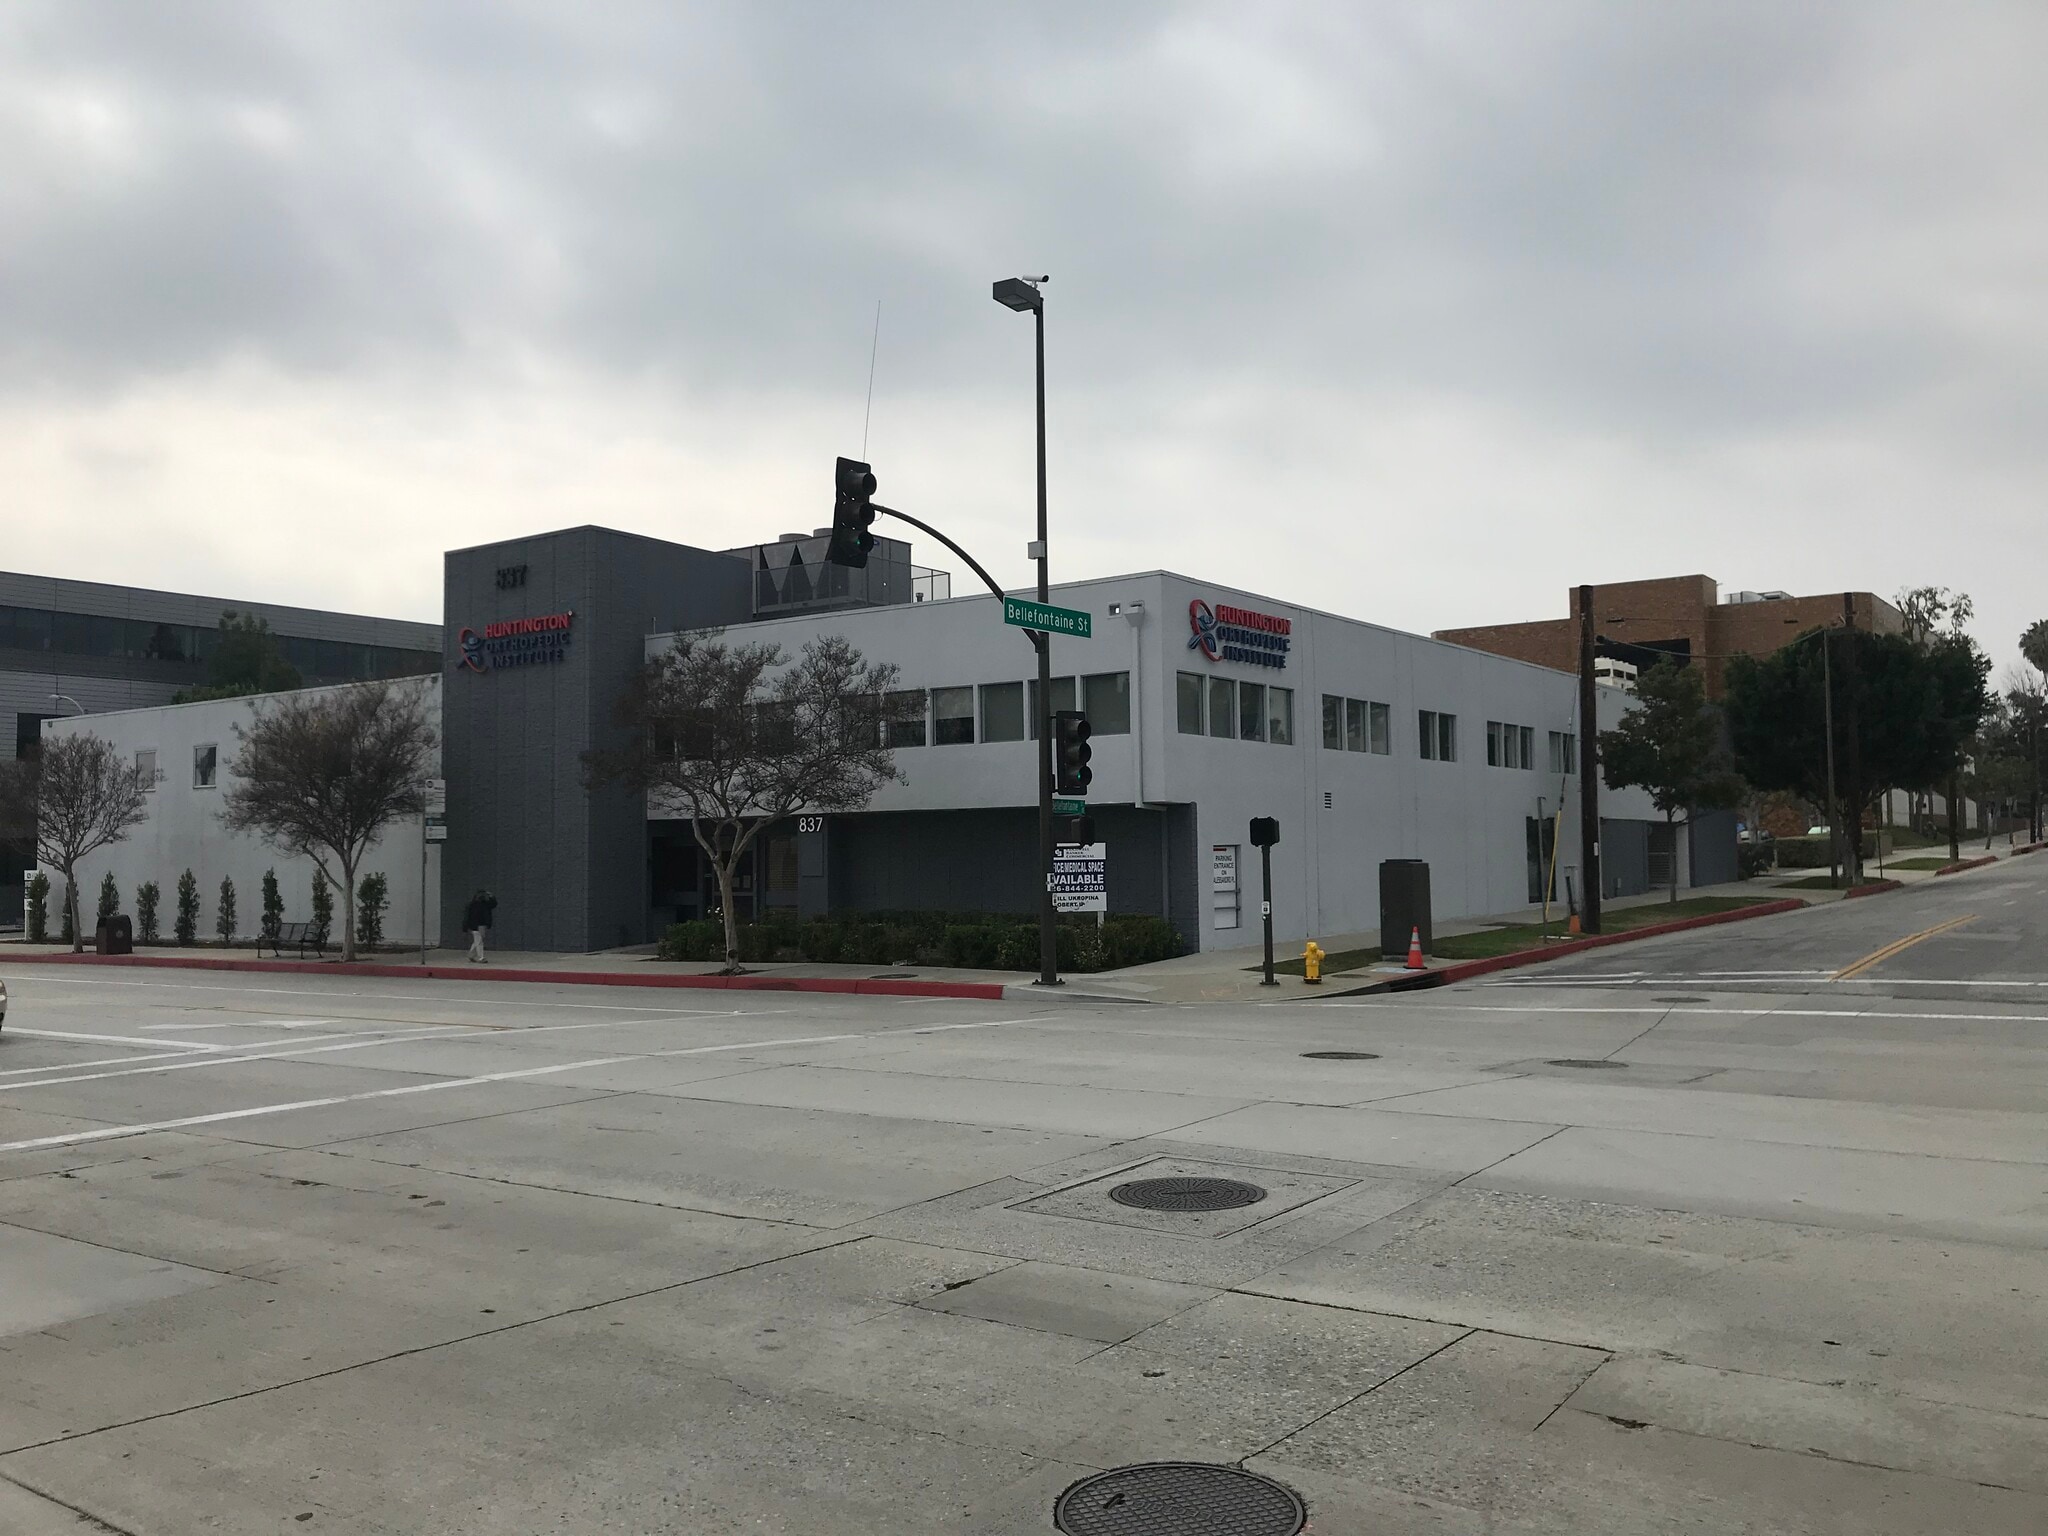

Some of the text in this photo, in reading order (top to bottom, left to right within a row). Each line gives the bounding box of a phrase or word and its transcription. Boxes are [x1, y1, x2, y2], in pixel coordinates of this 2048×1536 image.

[485, 613, 571, 638] HUNTINGTON
[1008, 604, 1088, 632] Bellefontaine St
[1216, 604, 1291, 635] HUNTINGTON
[485, 632, 570, 653] ORTHOPEDIC
[1216, 625, 1290, 652] ORTHOPEDIC
[1223, 645, 1286, 669] INSTITUTE
[799, 817, 823, 832] 837
[1053, 874, 1104, 884] VAILABLE
[1088, 862, 1104, 872] SPACE
